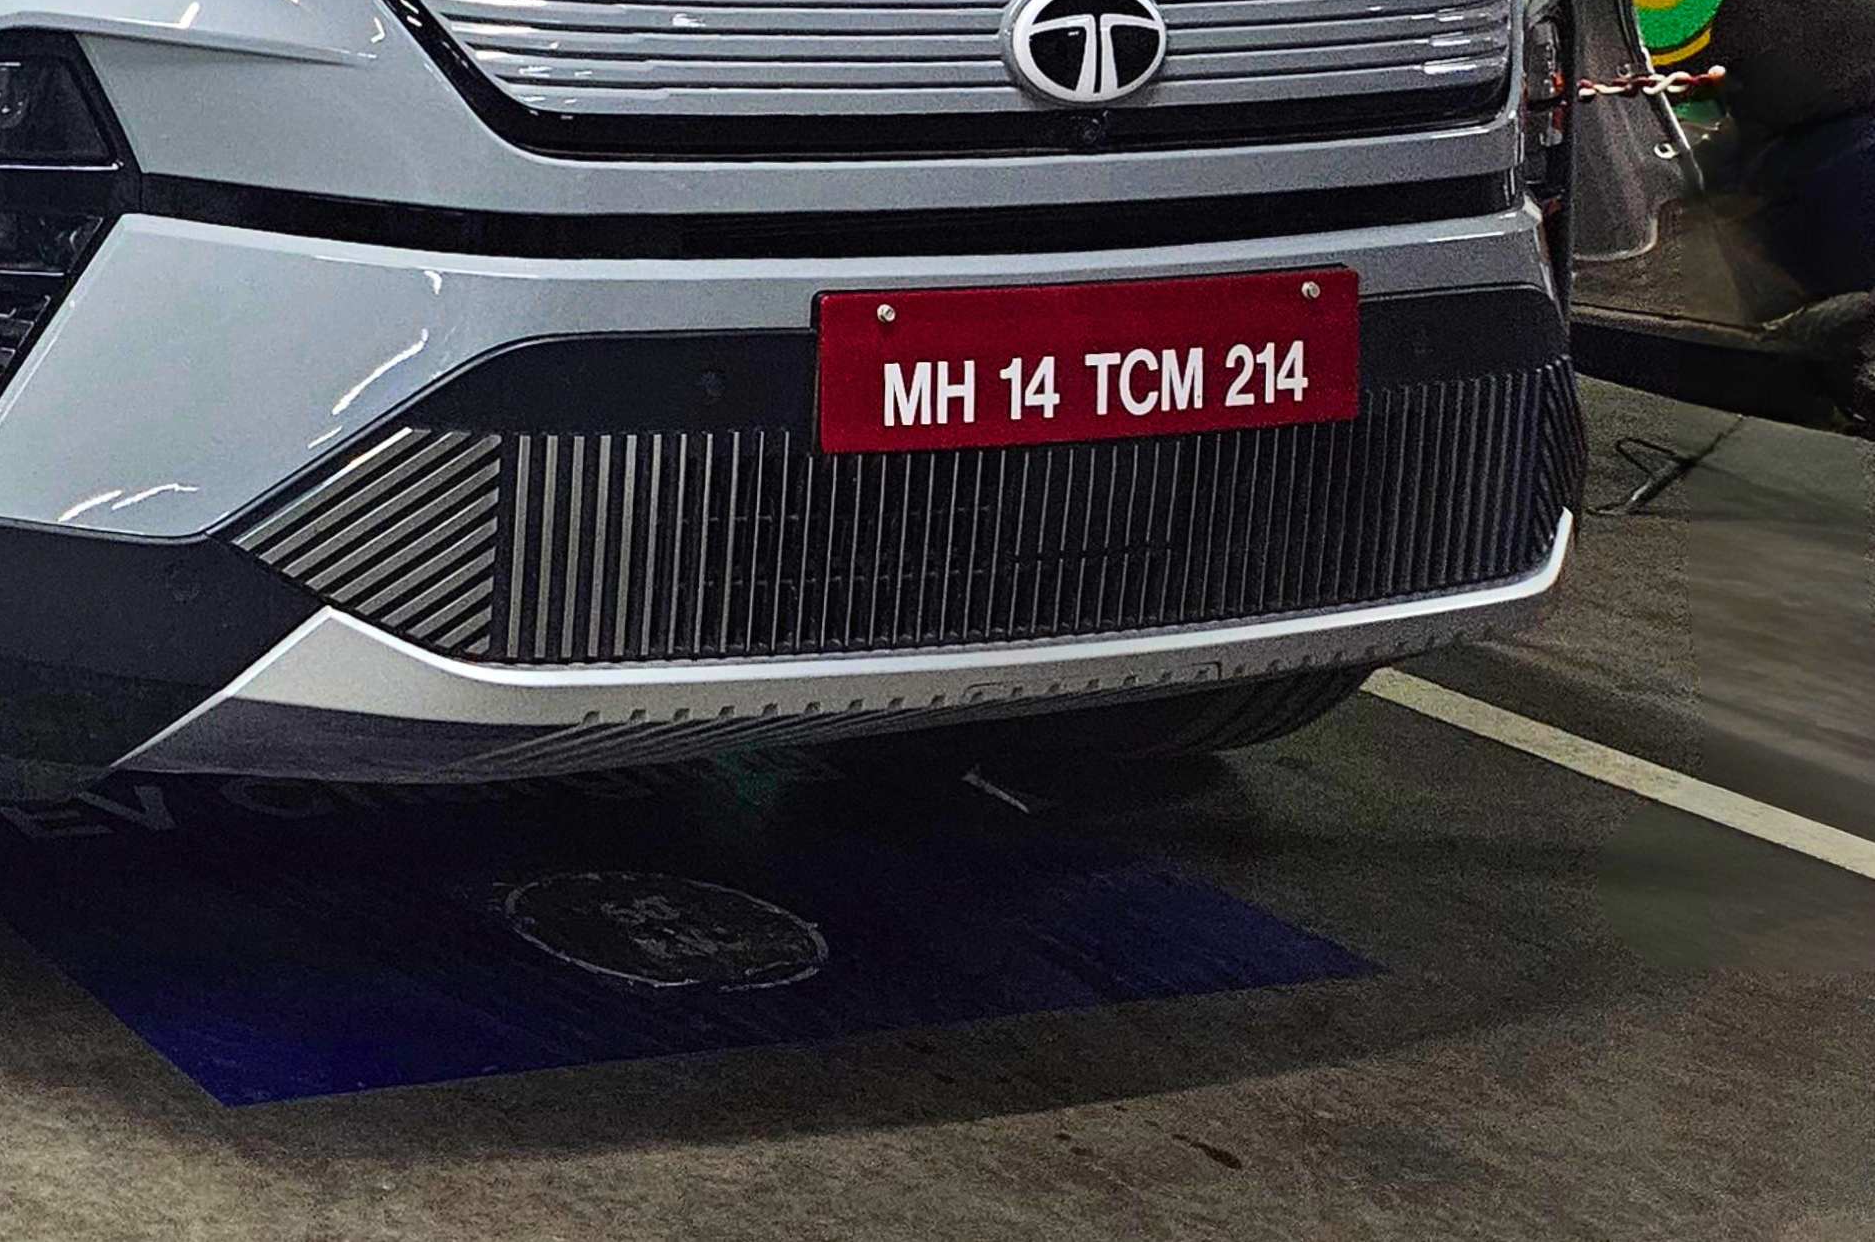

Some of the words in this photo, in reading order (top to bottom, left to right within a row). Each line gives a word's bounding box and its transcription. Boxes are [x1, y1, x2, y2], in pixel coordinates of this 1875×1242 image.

[884, 360, 976, 427] MH
[999, 356, 1060, 420] 14
[1084, 347, 1204, 417] TCM
[1225, 340, 1309, 407] 214
